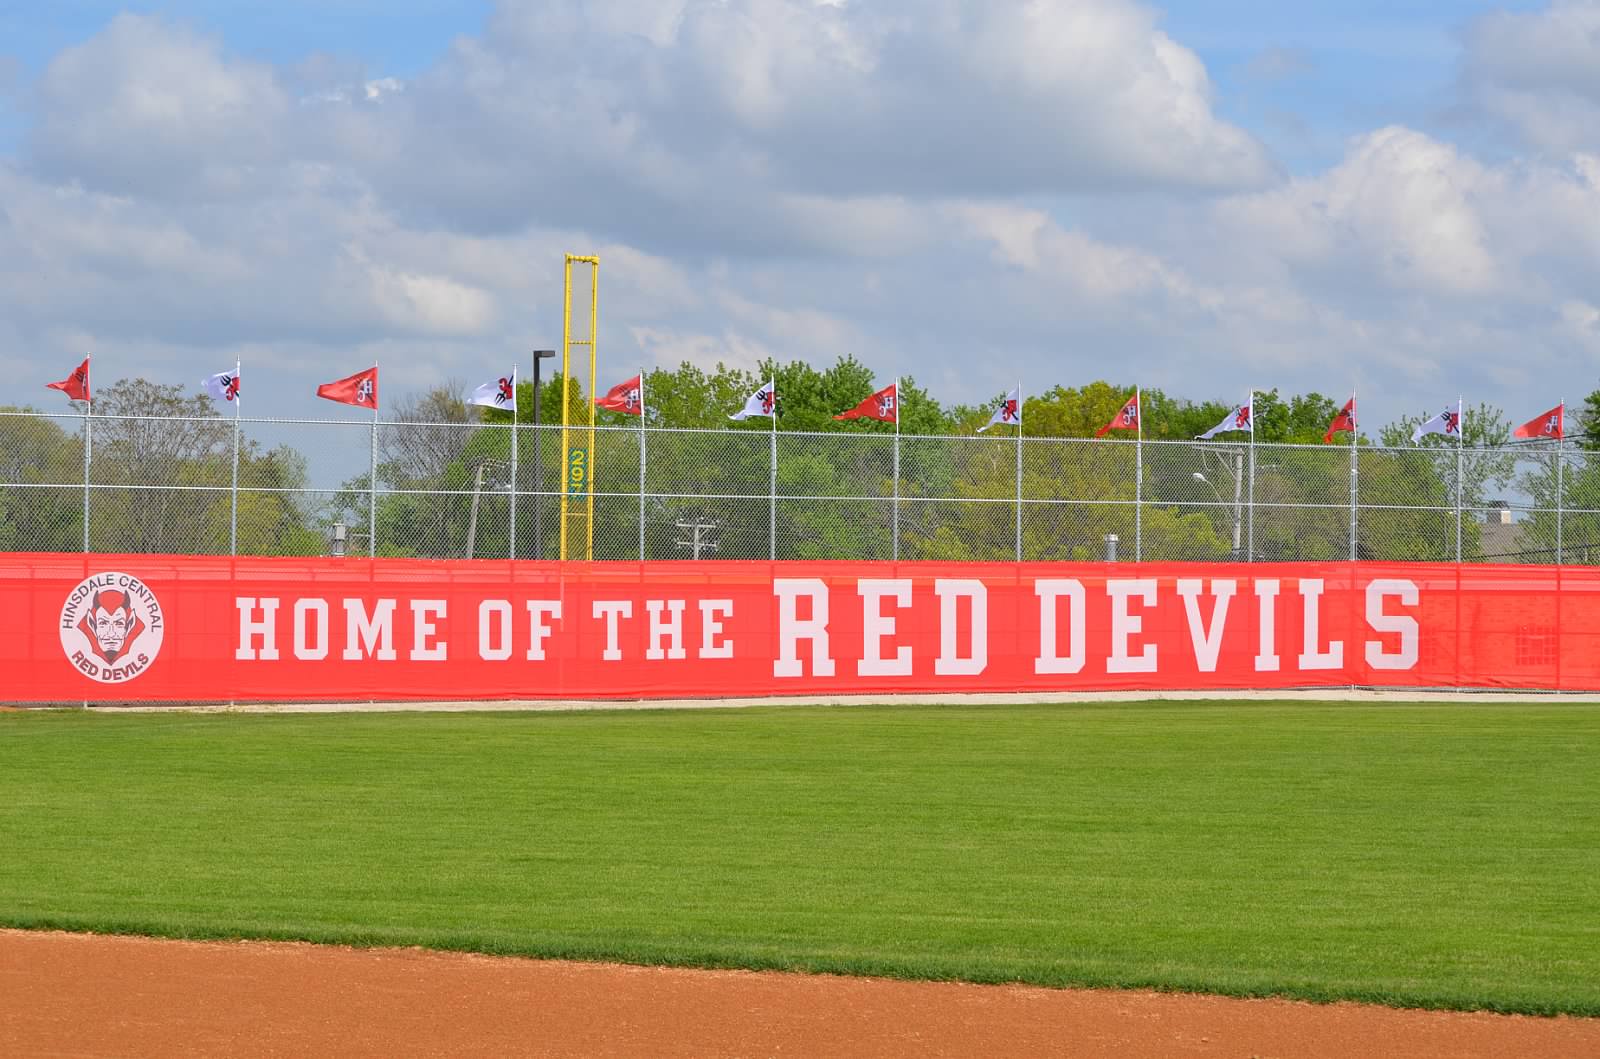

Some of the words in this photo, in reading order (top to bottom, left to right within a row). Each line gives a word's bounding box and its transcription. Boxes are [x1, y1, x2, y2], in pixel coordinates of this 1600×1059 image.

[62, 574, 115, 629] HINSDALE
[119, 576, 162, 633] CENTRAL
[236, 598, 447, 661] HOME
[478, 599, 562, 661] OF
[593, 599, 734, 661] THE
[774, 578, 988, 677] RED
[1035, 578, 1419, 674] DEVILS
[71, 650, 99, 677] RED
[102, 653, 149, 681] DEVILS
